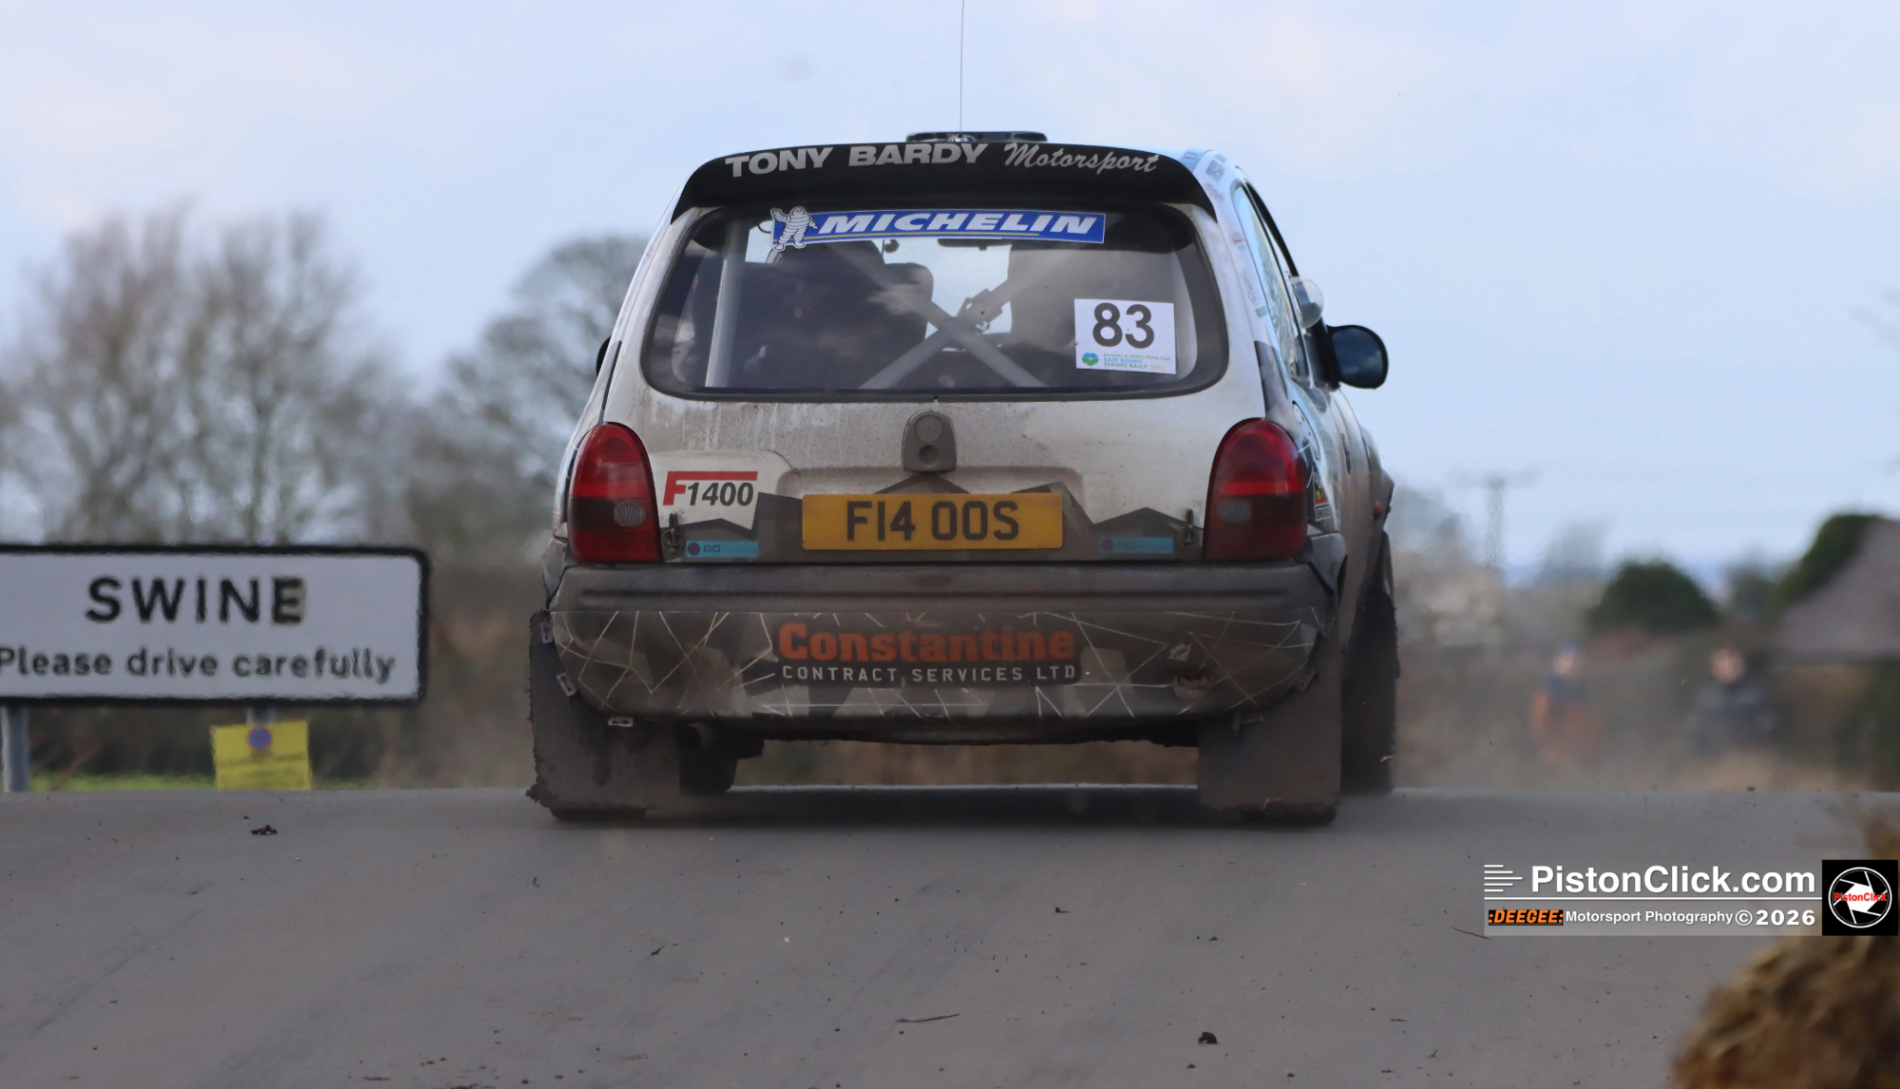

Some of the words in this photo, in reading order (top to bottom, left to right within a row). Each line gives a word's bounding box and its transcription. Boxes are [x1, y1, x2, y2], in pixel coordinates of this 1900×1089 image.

[725, 146, 834, 178] TONY
[848, 143, 989, 167] BARDY
[1004, 142, 1159, 175] Motorsport
[818, 212, 1098, 235] MICHELIN
[1092, 302, 1155, 349] 83
[663, 471, 758, 506] F1400
[847, 501, 916, 541] F14
[931, 501, 1020, 540] OOS
[703, 545, 721, 553] GO
[85, 575, 306, 624] SWINE
[779, 622, 1076, 662] Constantine
[0, 646, 113, 676] Please
[126, 647, 219, 677] drive
[232, 647, 396, 685] carefully
[783, 666, 897, 682] CONTRACT
[912, 666, 1023, 682] SERVICES
[1036, 665, 1076, 680] LTD
